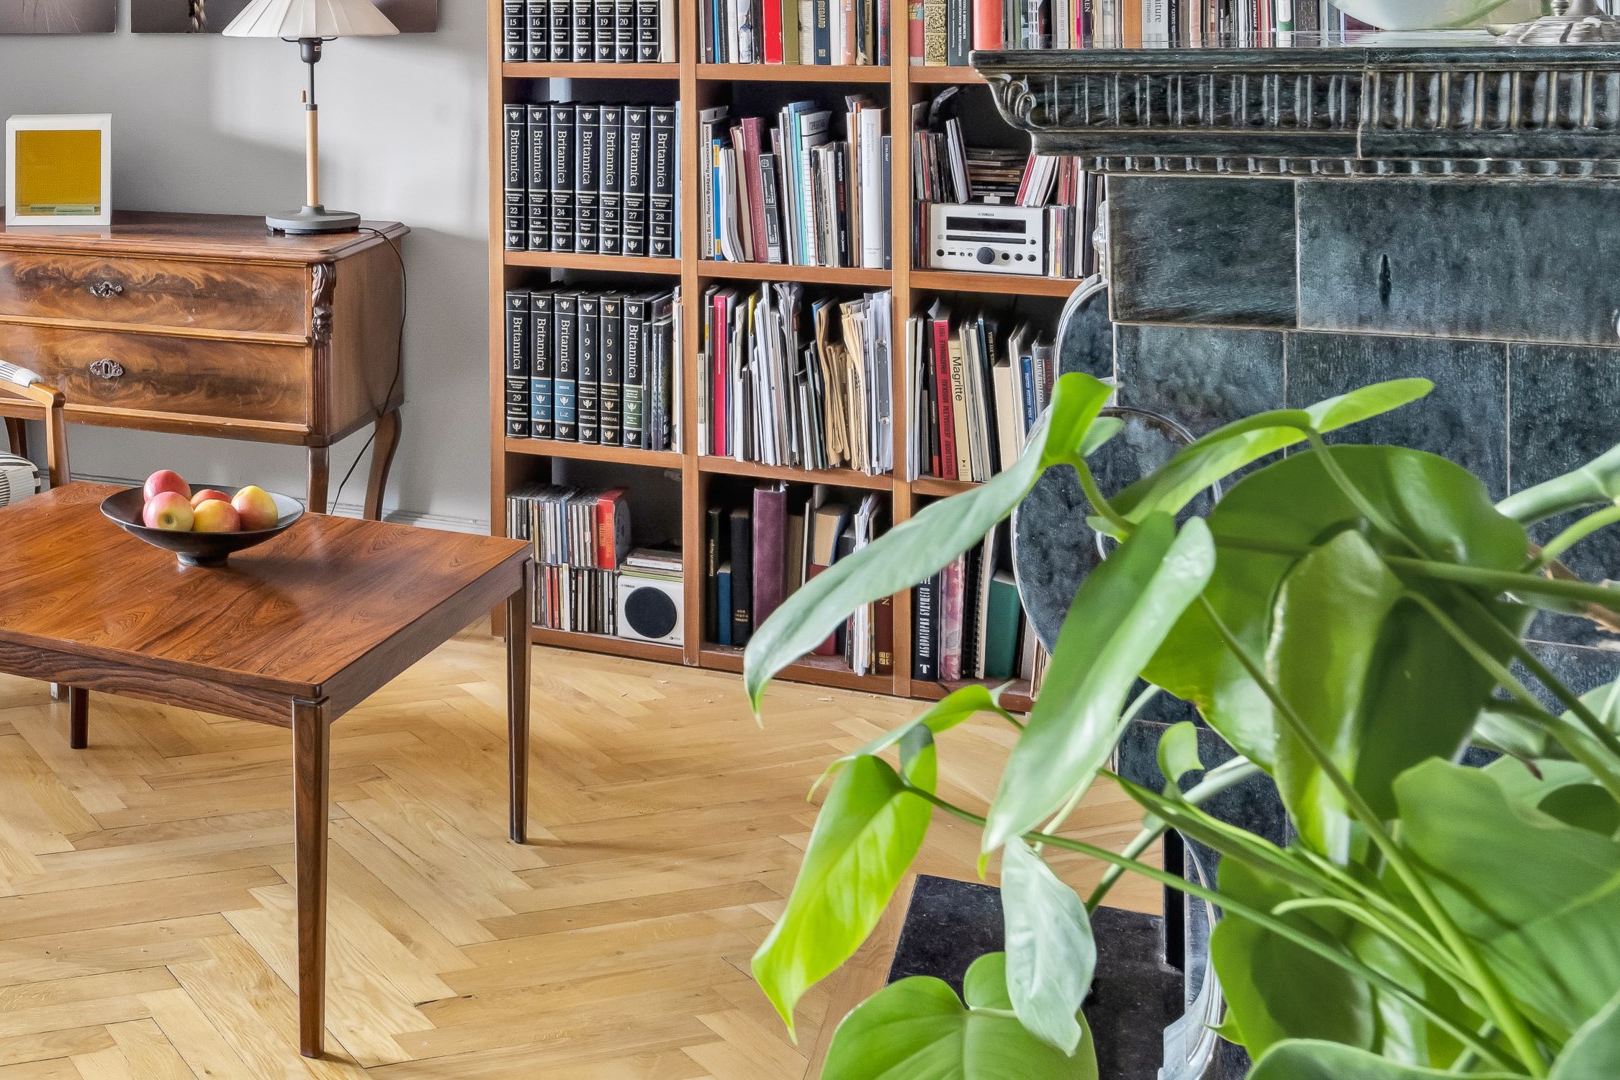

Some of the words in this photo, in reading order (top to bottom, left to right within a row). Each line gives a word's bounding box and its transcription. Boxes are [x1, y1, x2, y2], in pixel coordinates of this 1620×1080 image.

[510, 130, 519, 182] Britannica
[534, 130, 543, 183] Britannica
[558, 130, 567, 184] Britannica
[583, 131, 592, 185] Britannica
[607, 132, 616, 185] Britannica
[630, 132, 640, 187] Britannica
[657, 133, 667, 187] Britannica
[513, 317, 522, 370] Britannica
[537, 318, 546, 371] Britannica
[561, 320, 570, 372] Britannica
[628, 324, 638, 378] Britannica
[952, 356, 963, 401] Magritte
[919, 588, 930, 616] БУДУЩЕГО
[919, 618, 930, 658] ЛАБОРАТОРИЯ
